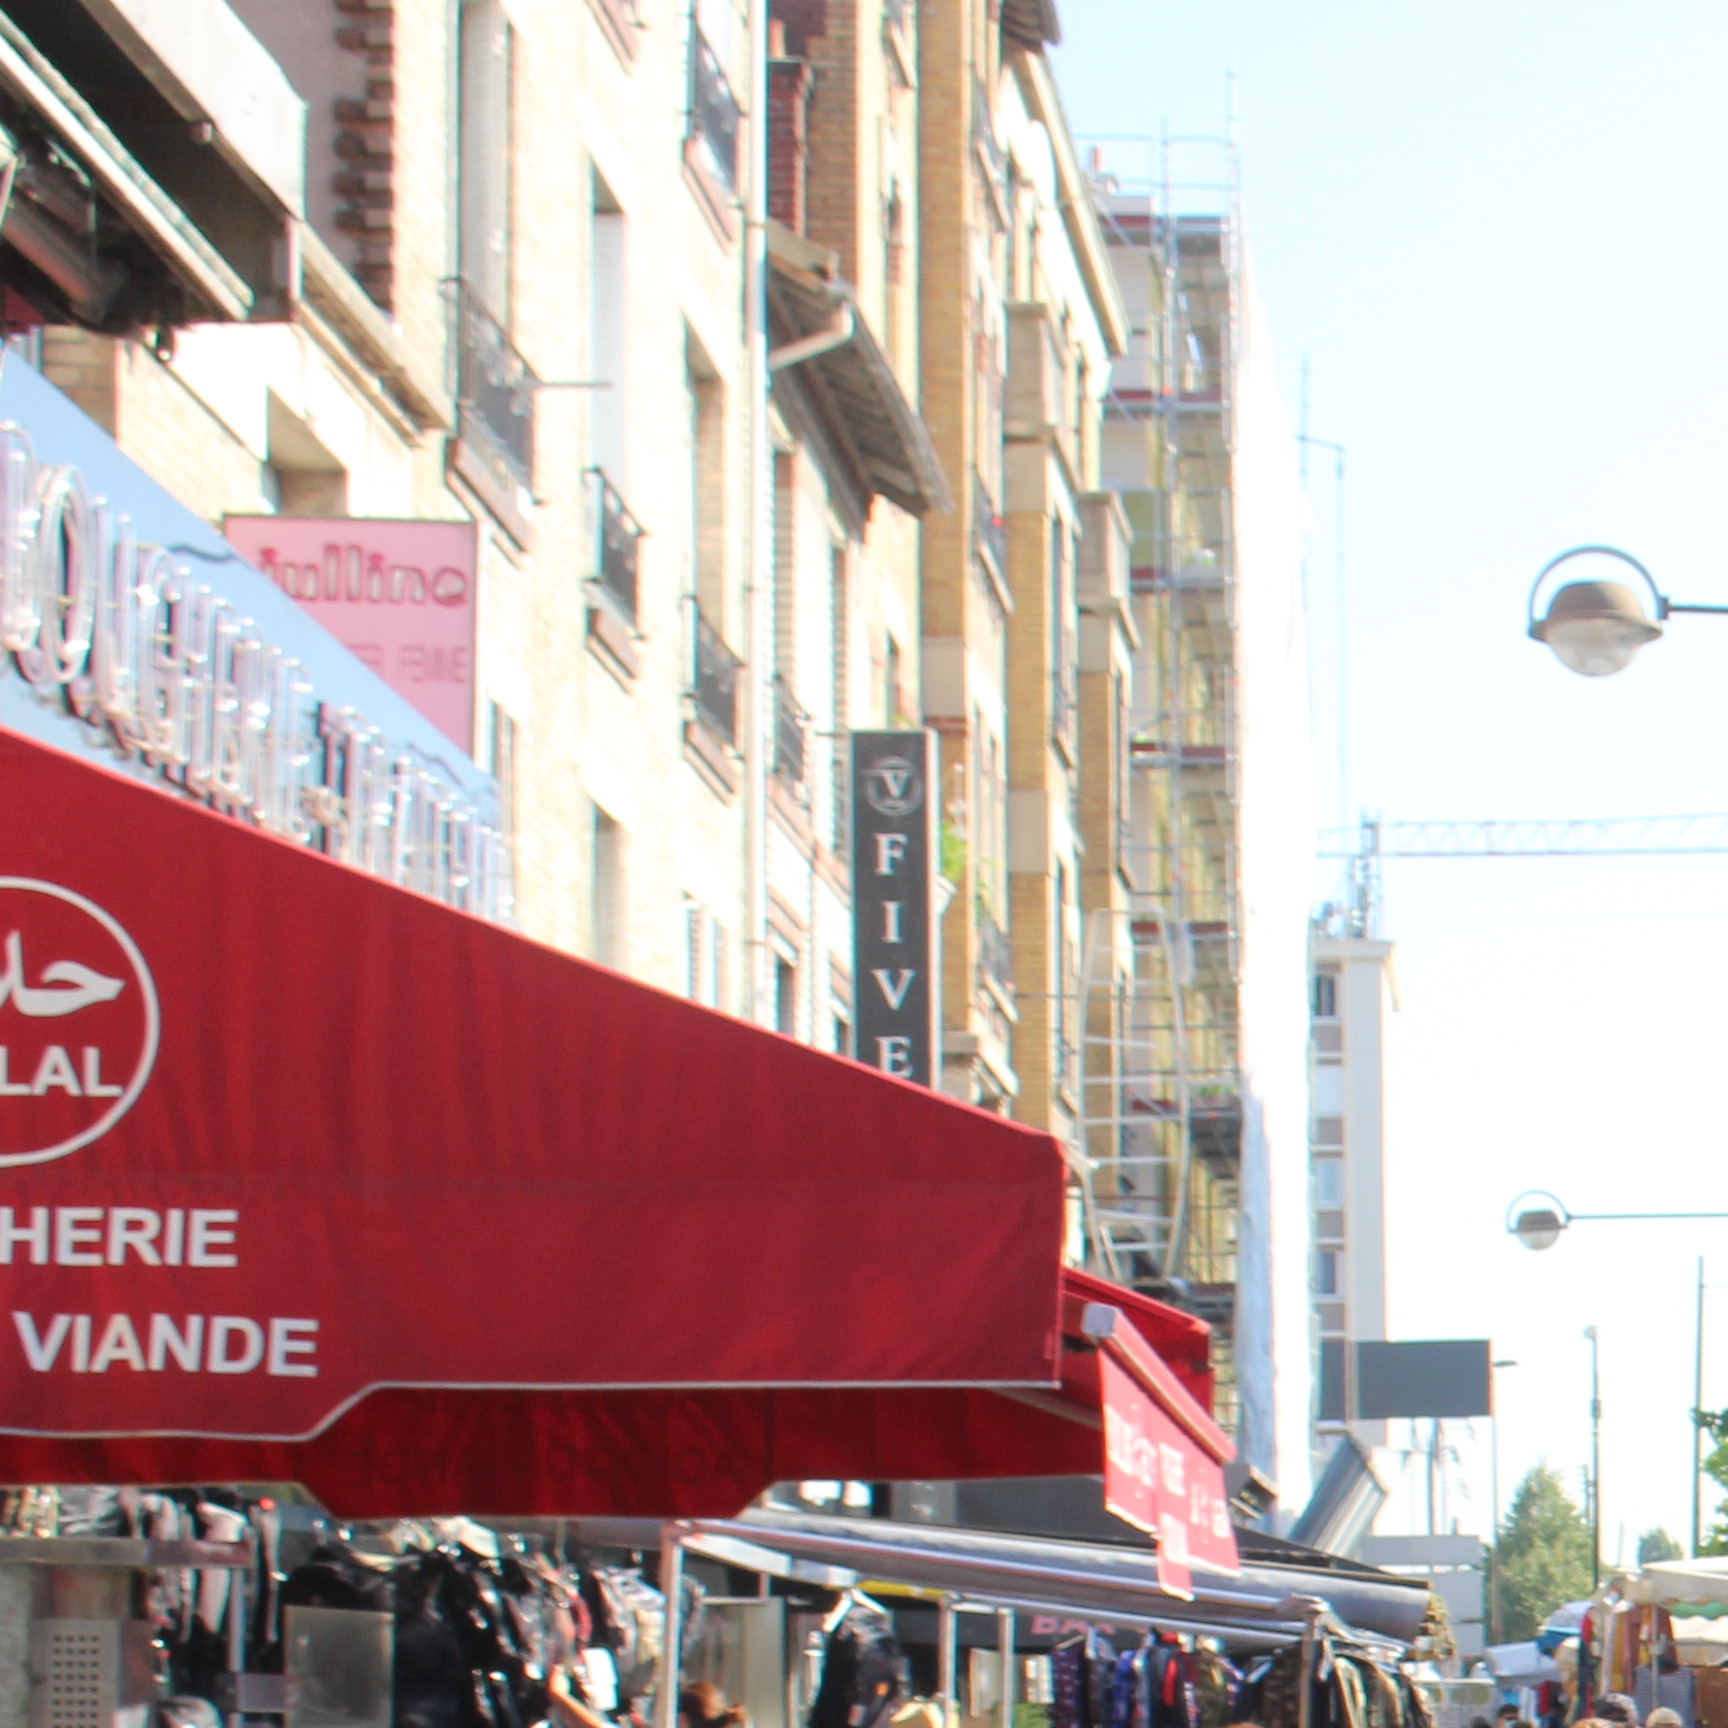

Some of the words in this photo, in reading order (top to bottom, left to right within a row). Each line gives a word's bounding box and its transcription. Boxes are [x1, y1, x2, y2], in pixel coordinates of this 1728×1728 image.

[0, 1045, 124, 1098] LAL
[0, 1205, 240, 1269] HERIE
[12, 1310, 320, 1378] VIANDE
